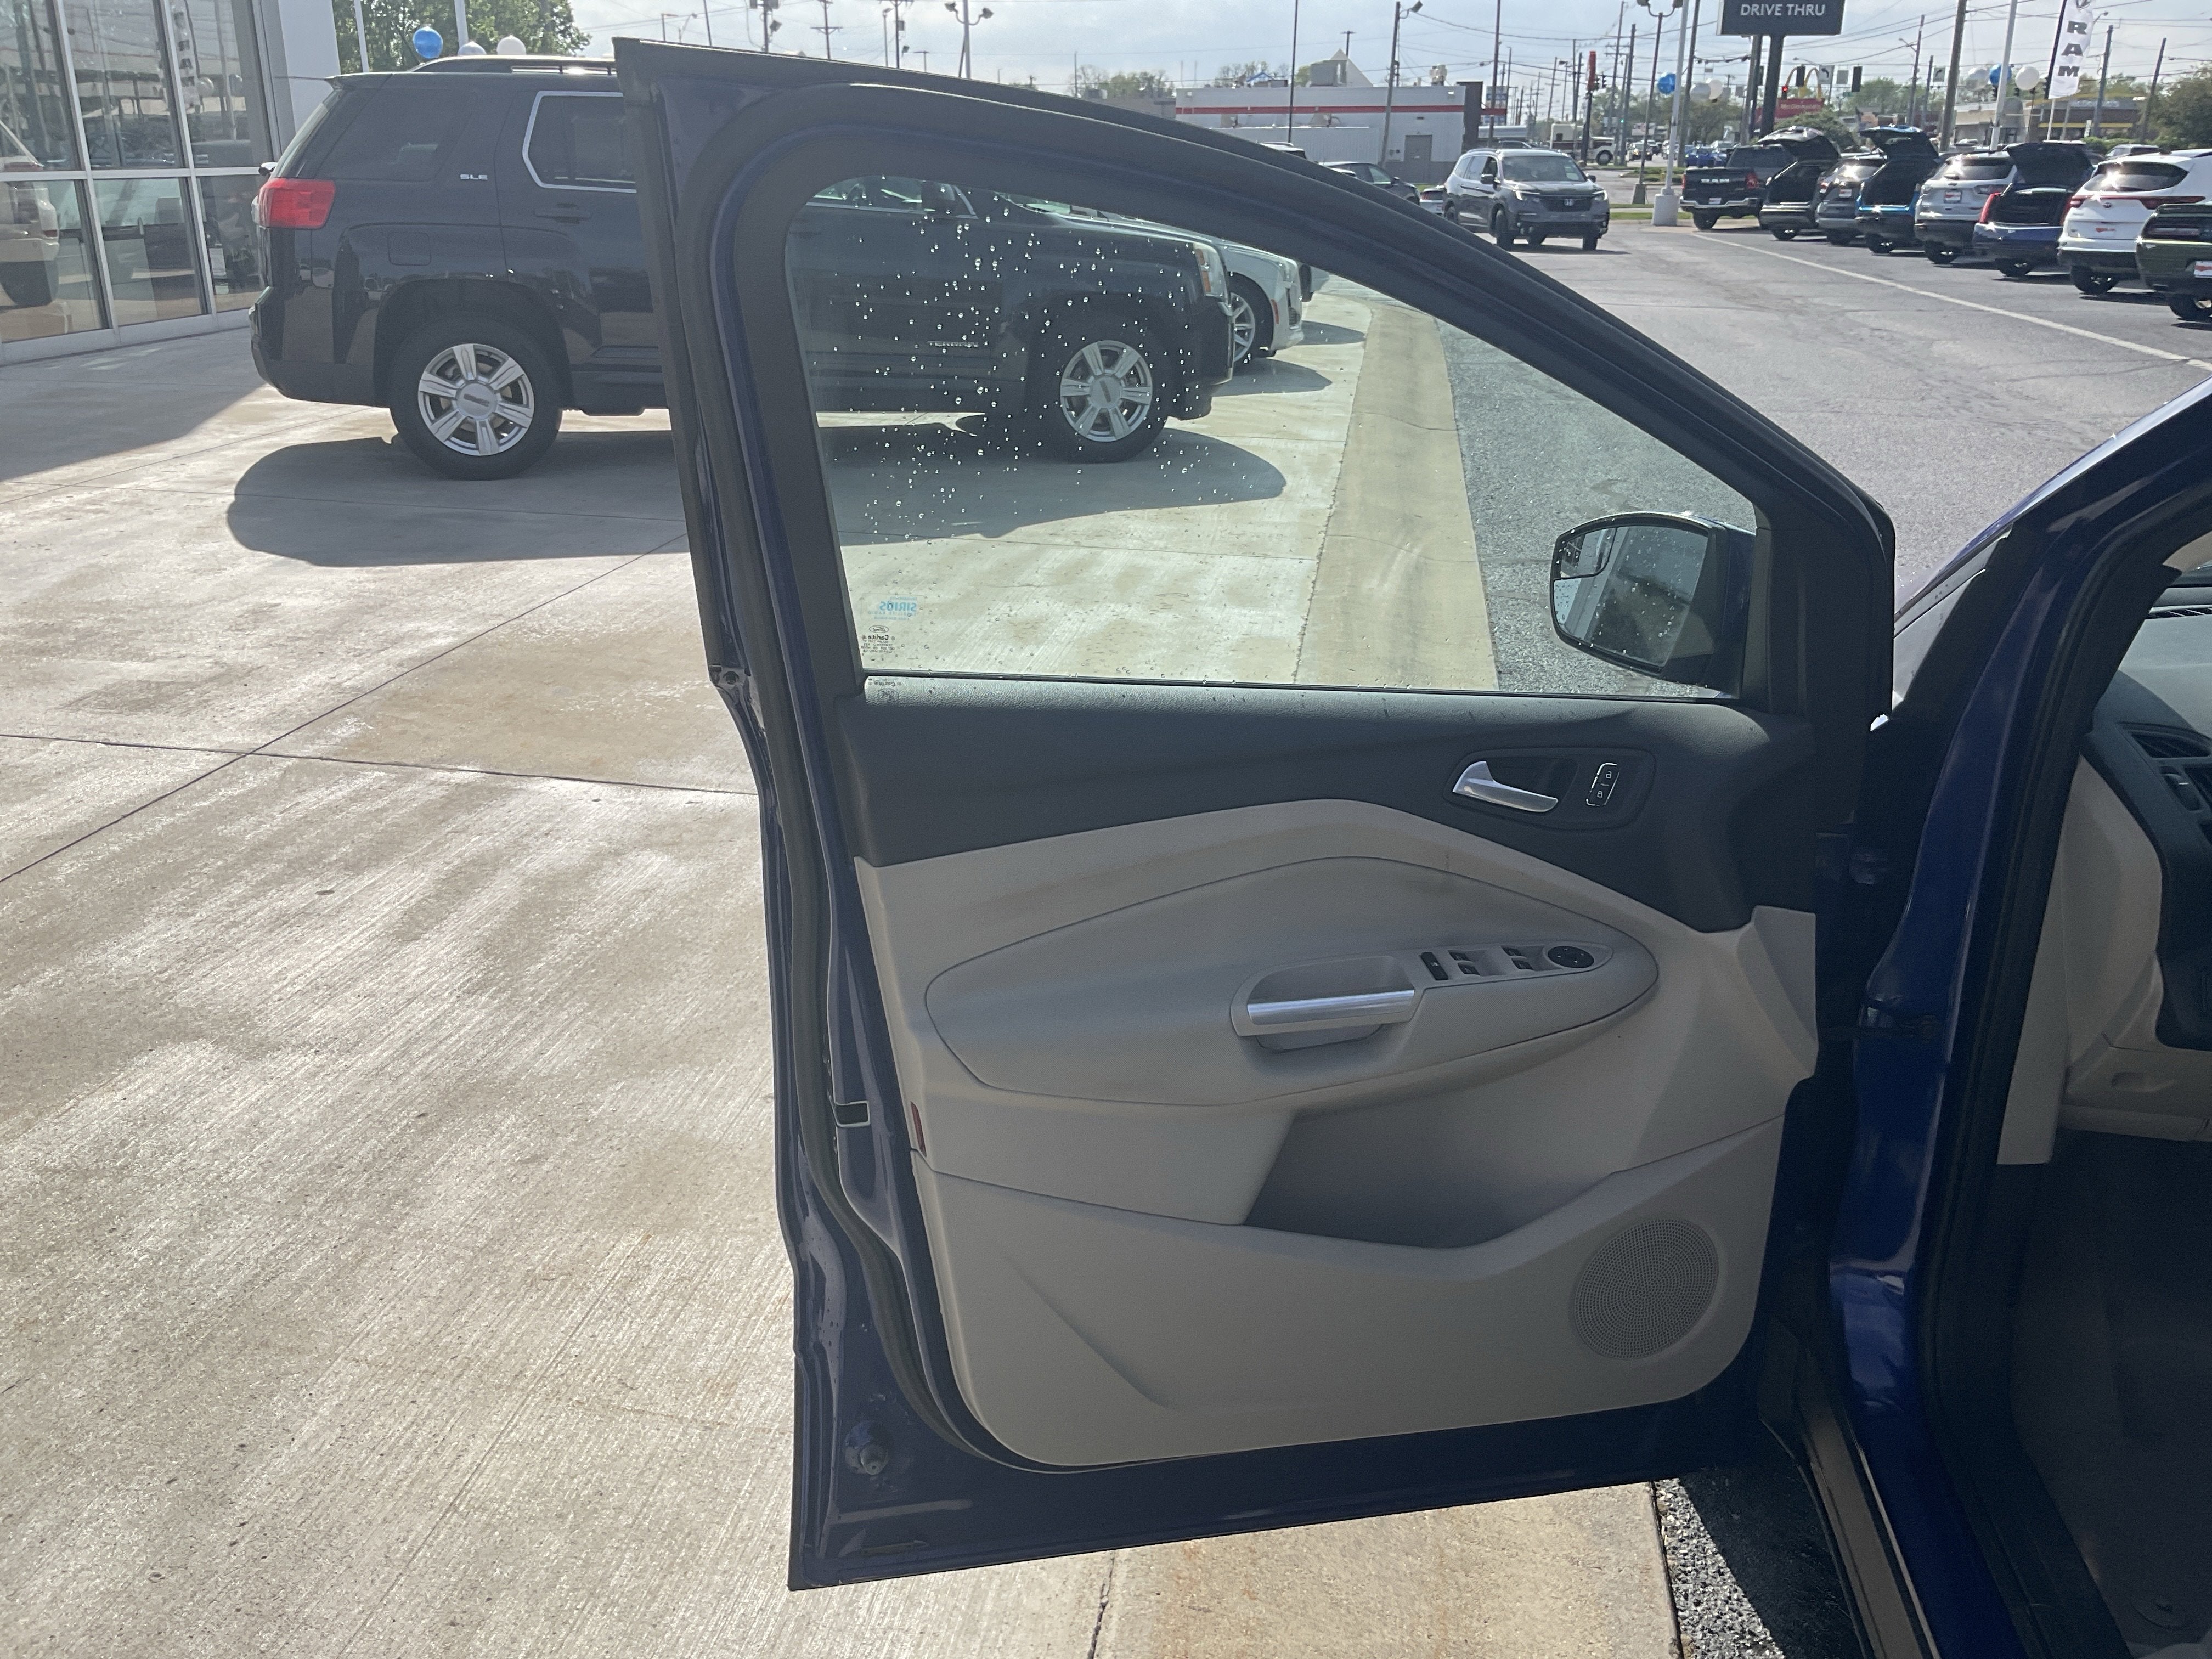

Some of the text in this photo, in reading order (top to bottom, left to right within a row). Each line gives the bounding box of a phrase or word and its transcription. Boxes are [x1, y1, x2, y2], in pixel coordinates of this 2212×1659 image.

[1740, 3, 1825, 16] DRIVE THRU
[2057, 20, 2088, 77] RAM
